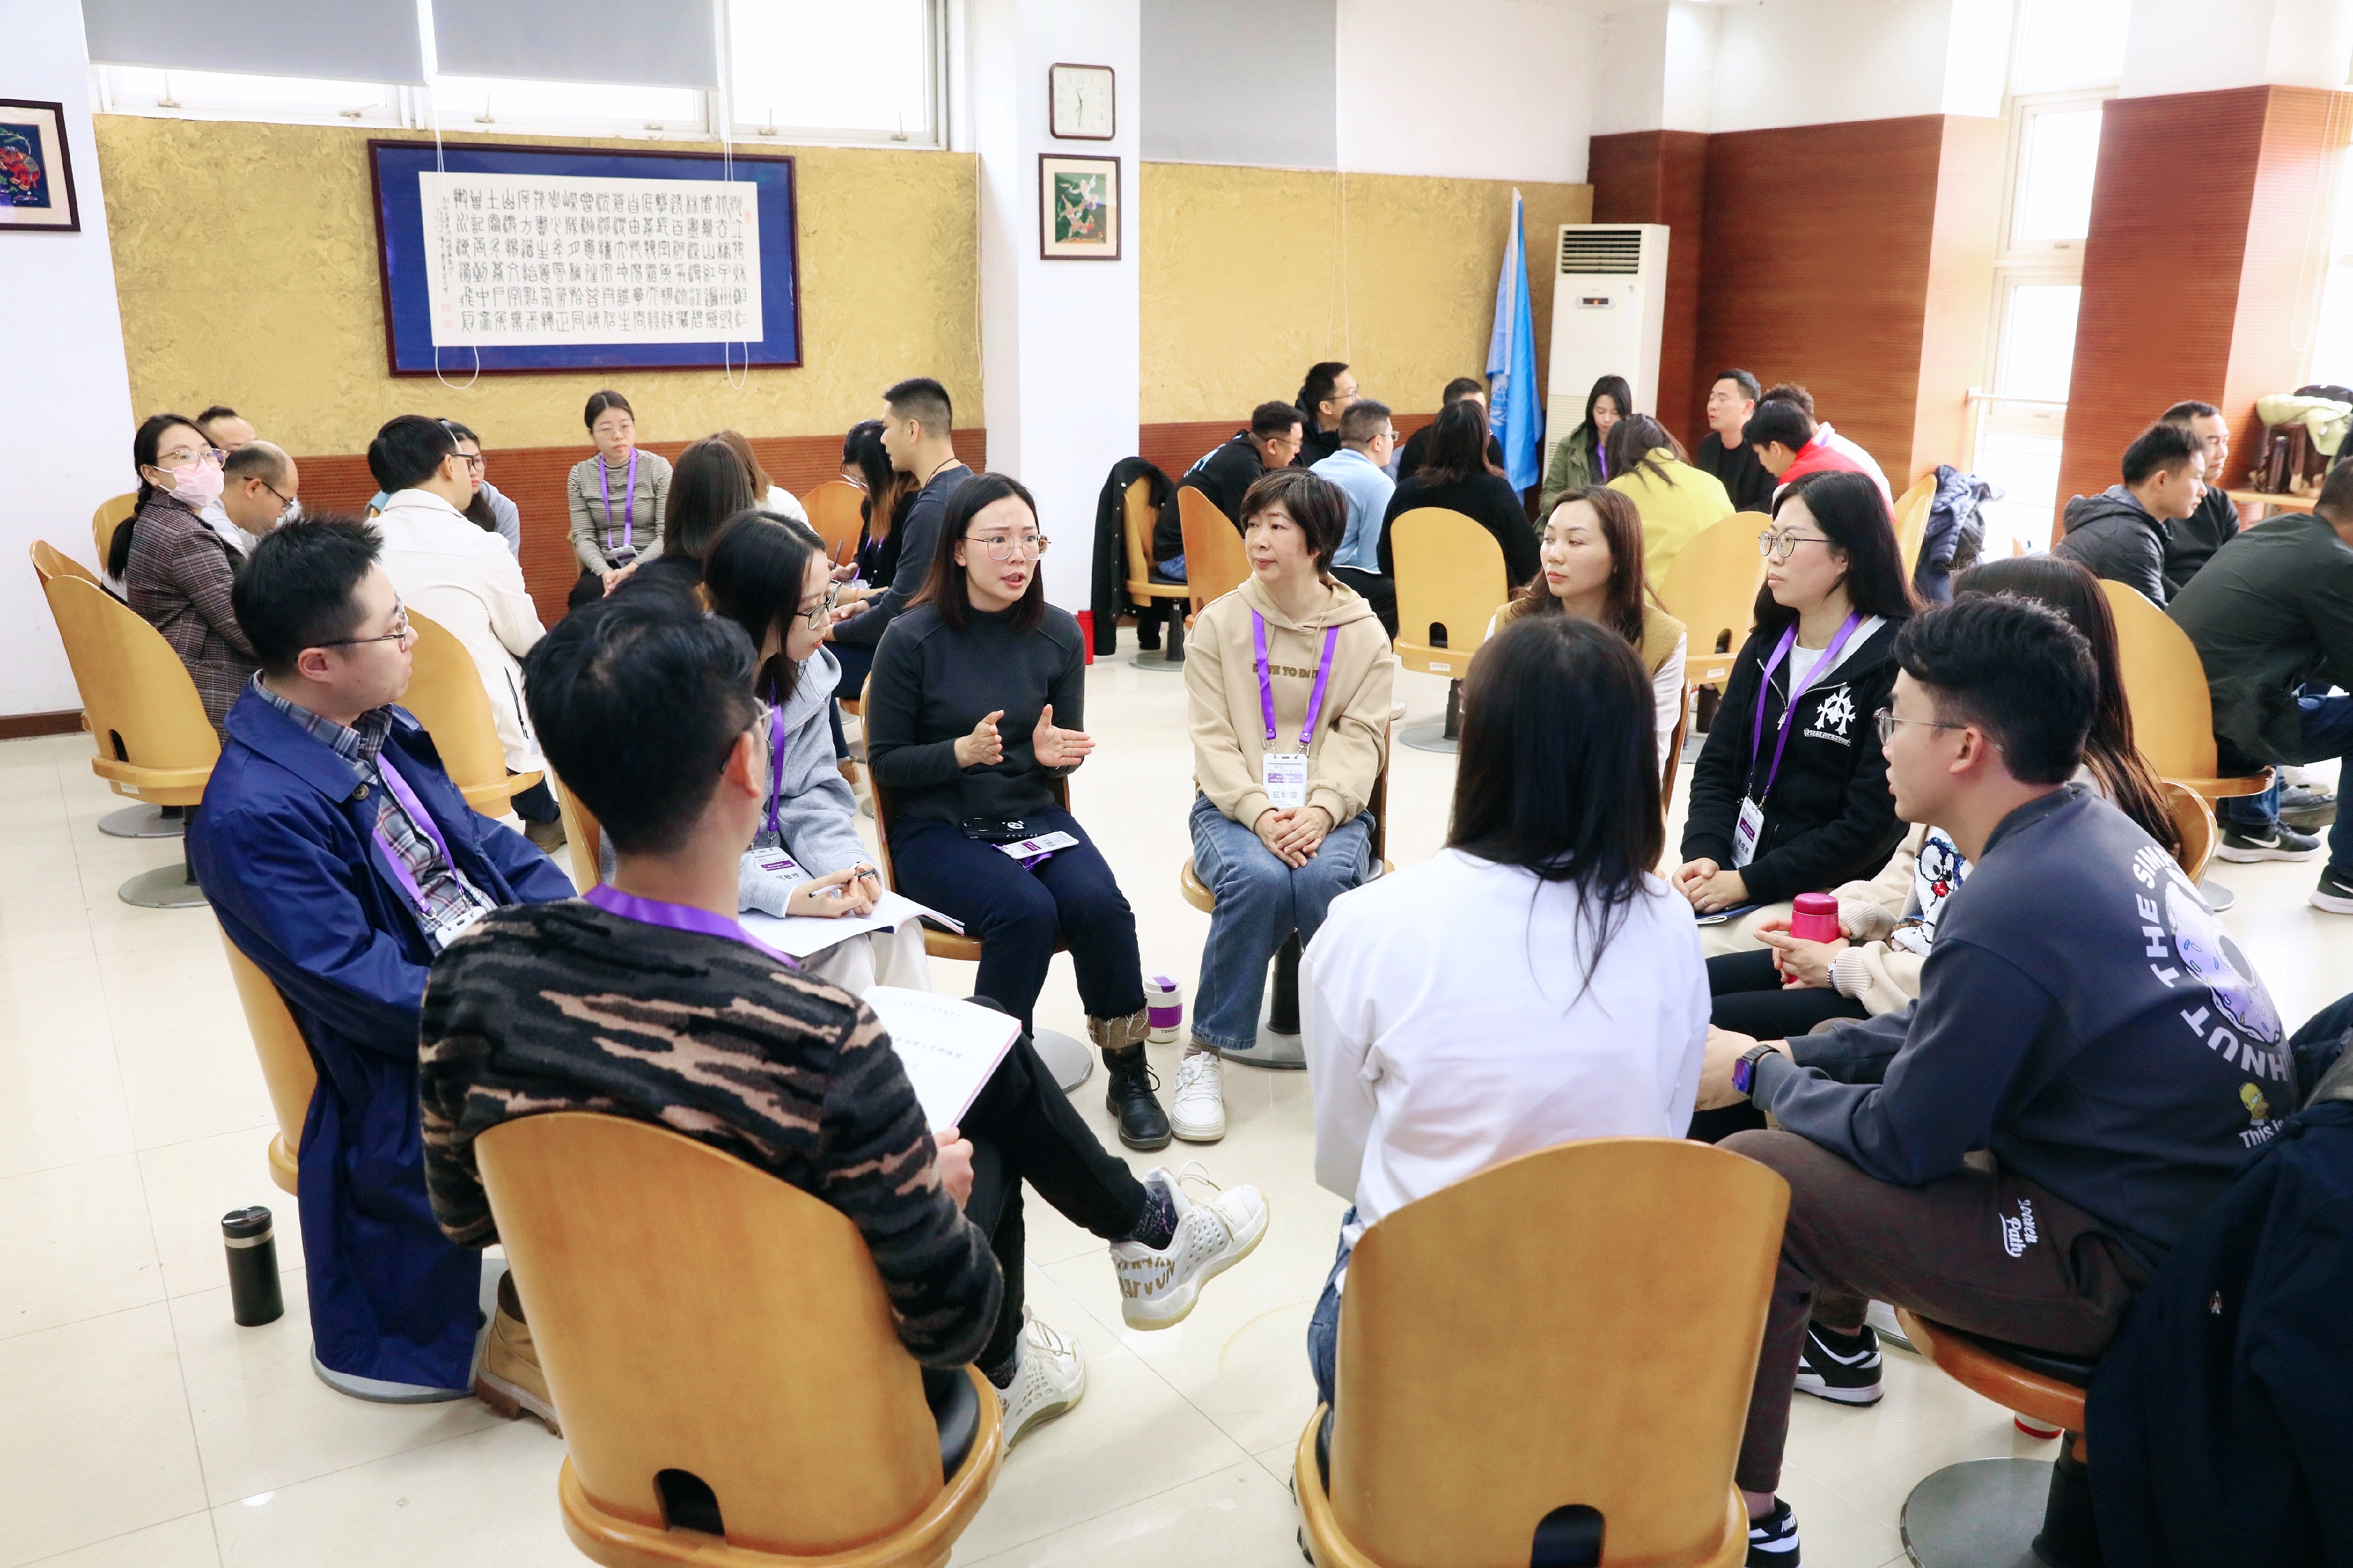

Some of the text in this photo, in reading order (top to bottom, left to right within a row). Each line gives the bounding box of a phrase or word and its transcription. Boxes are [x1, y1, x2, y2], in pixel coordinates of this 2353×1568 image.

[2133, 846, 2180, 988] THE SIMP
[2238, 1126, 2275, 1148] This
